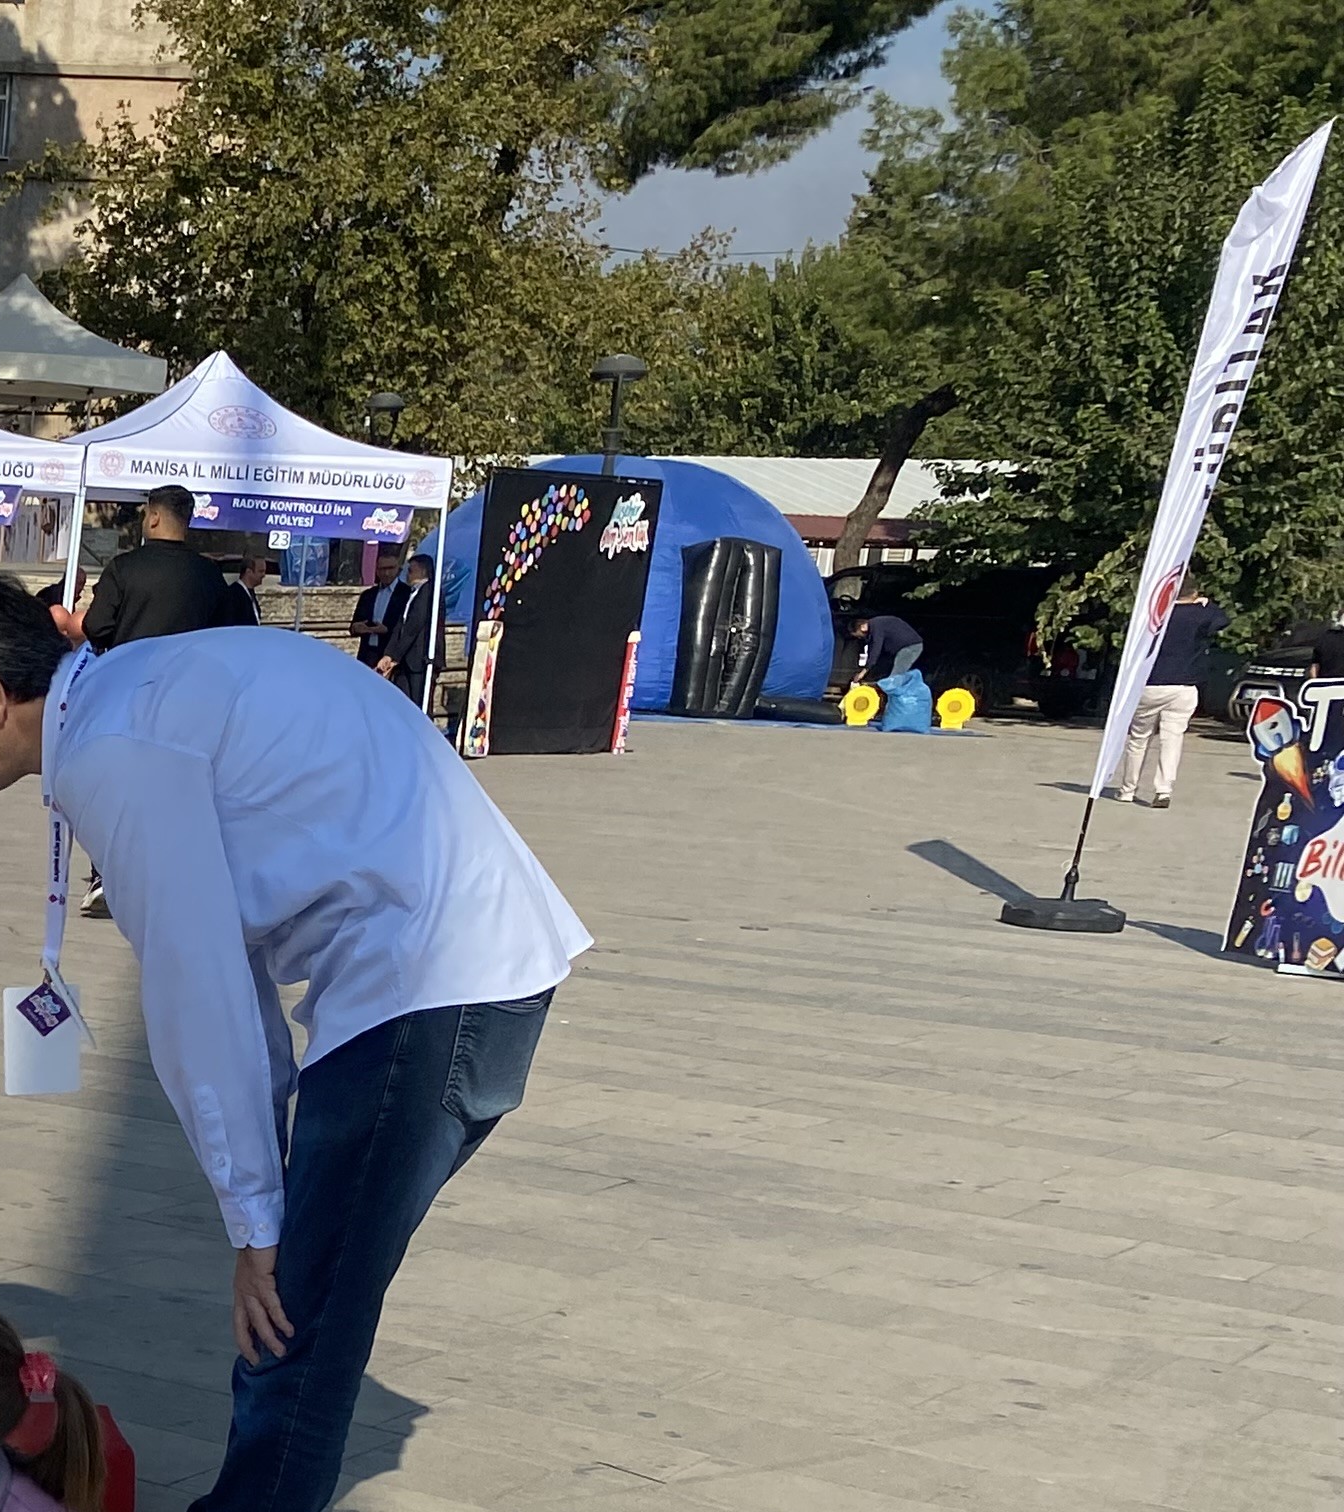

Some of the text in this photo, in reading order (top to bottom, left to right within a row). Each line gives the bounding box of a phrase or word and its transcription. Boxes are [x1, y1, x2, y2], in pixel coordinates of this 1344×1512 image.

[130, 459, 406, 490] MANİSA İL MİLLİ EĞİTİM MÜDÜRLÜĞÜ
[232, 498, 269, 511] RADYO
[270, 501, 332, 516] KONTROLLÜ
[333, 502, 352, 516] İHA
[266, 512, 314, 528] ATÖLYESİ
[270, 531, 290, 547] 23
